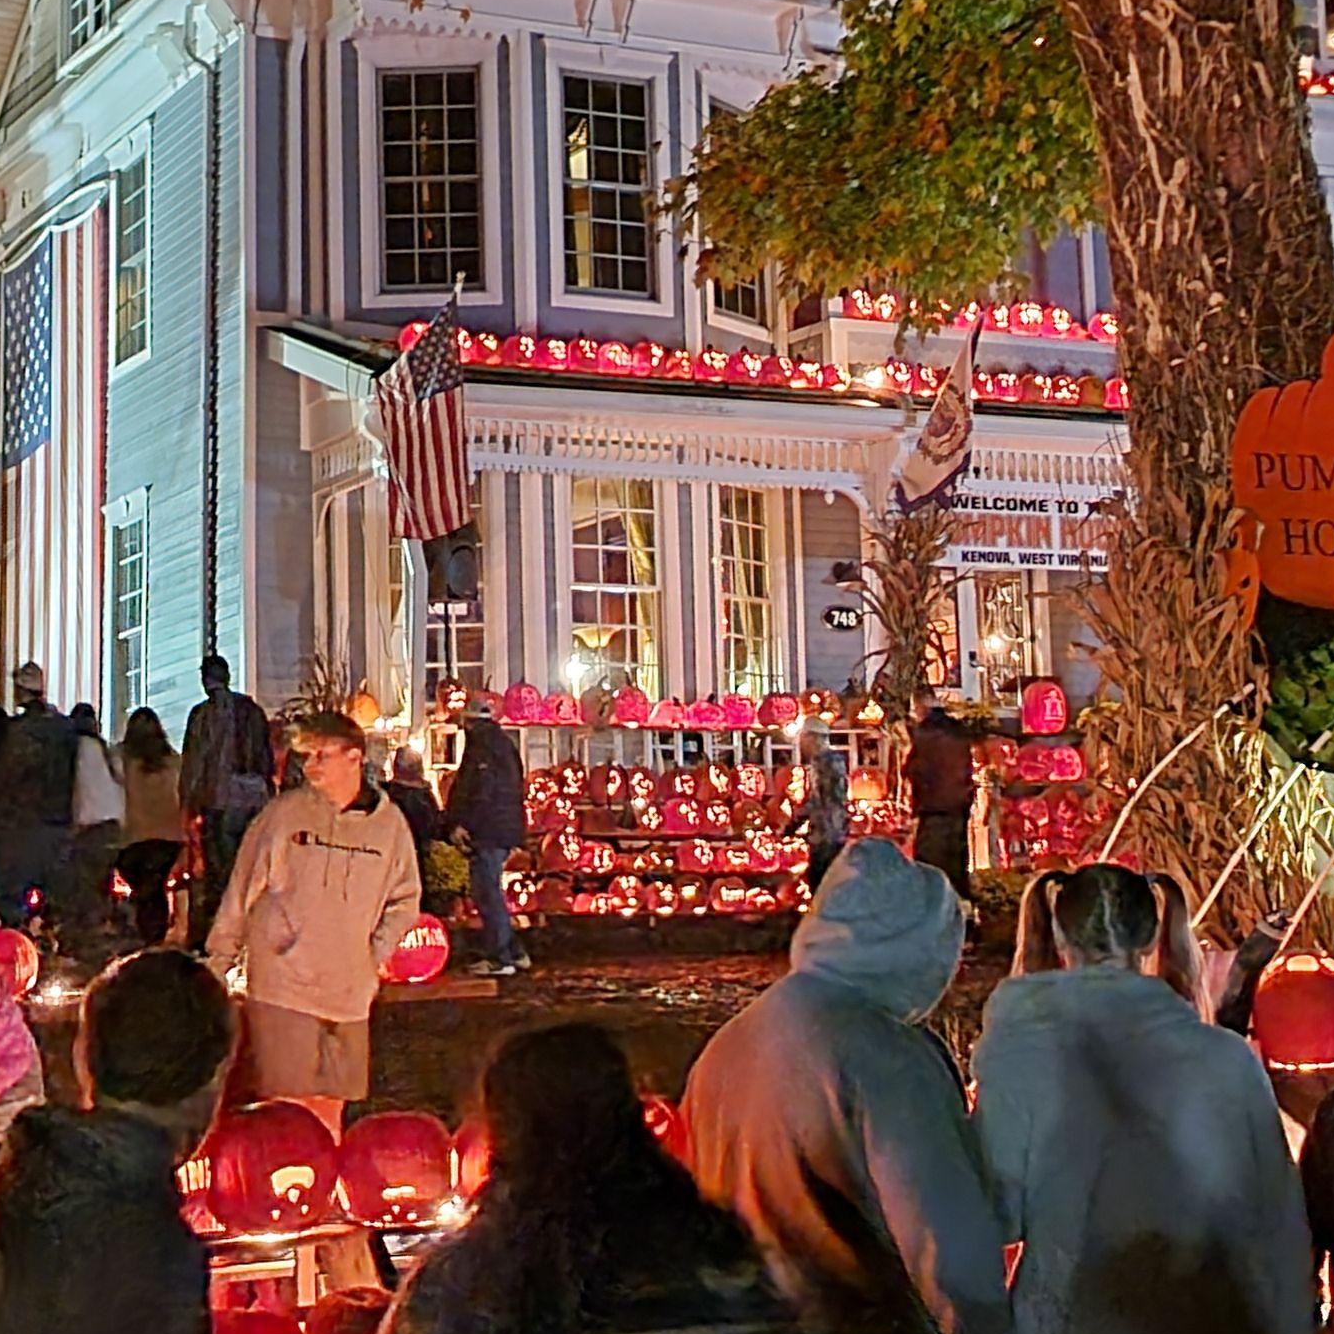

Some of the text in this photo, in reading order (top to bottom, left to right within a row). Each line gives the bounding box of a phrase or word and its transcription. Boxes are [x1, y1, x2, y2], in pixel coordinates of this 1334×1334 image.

[951, 496, 1048, 512] WELCOME
[1055, 499, 1079, 514] TO
[961, 550, 1015, 566] KENOVA,
[1018, 552, 1054, 565] WEST
[830, 610, 857, 627] 748
